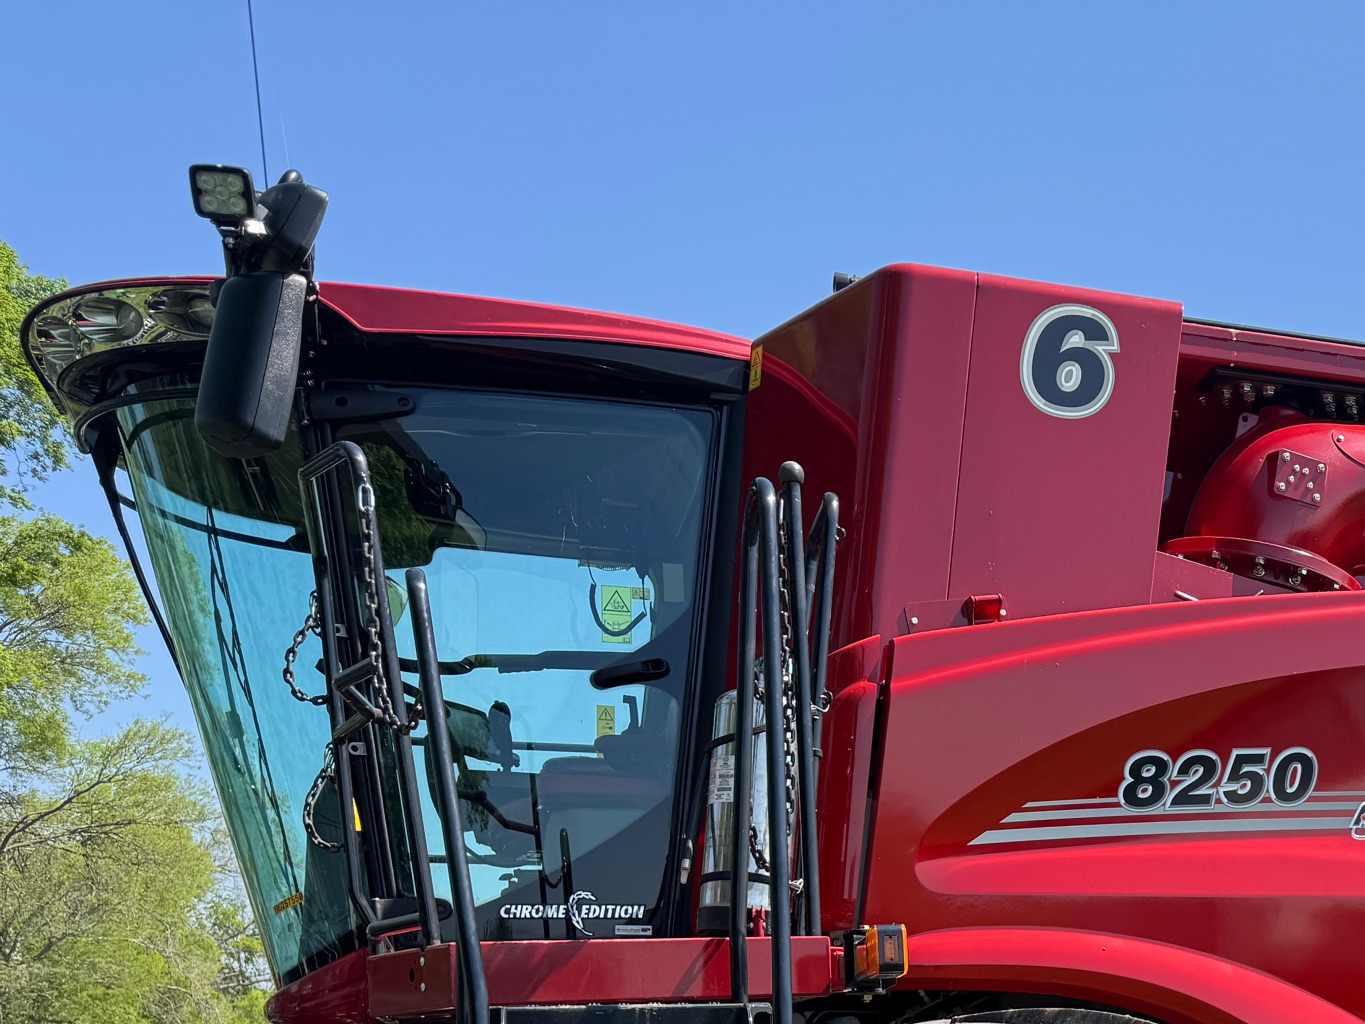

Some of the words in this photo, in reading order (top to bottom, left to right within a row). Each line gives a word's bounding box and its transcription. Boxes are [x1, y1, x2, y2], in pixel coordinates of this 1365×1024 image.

[1020, 303, 1120, 419] 6
[1118, 747, 1318, 812] 8250
[500, 904, 567, 919] CHROME
[581, 904, 645, 919] EDITION
